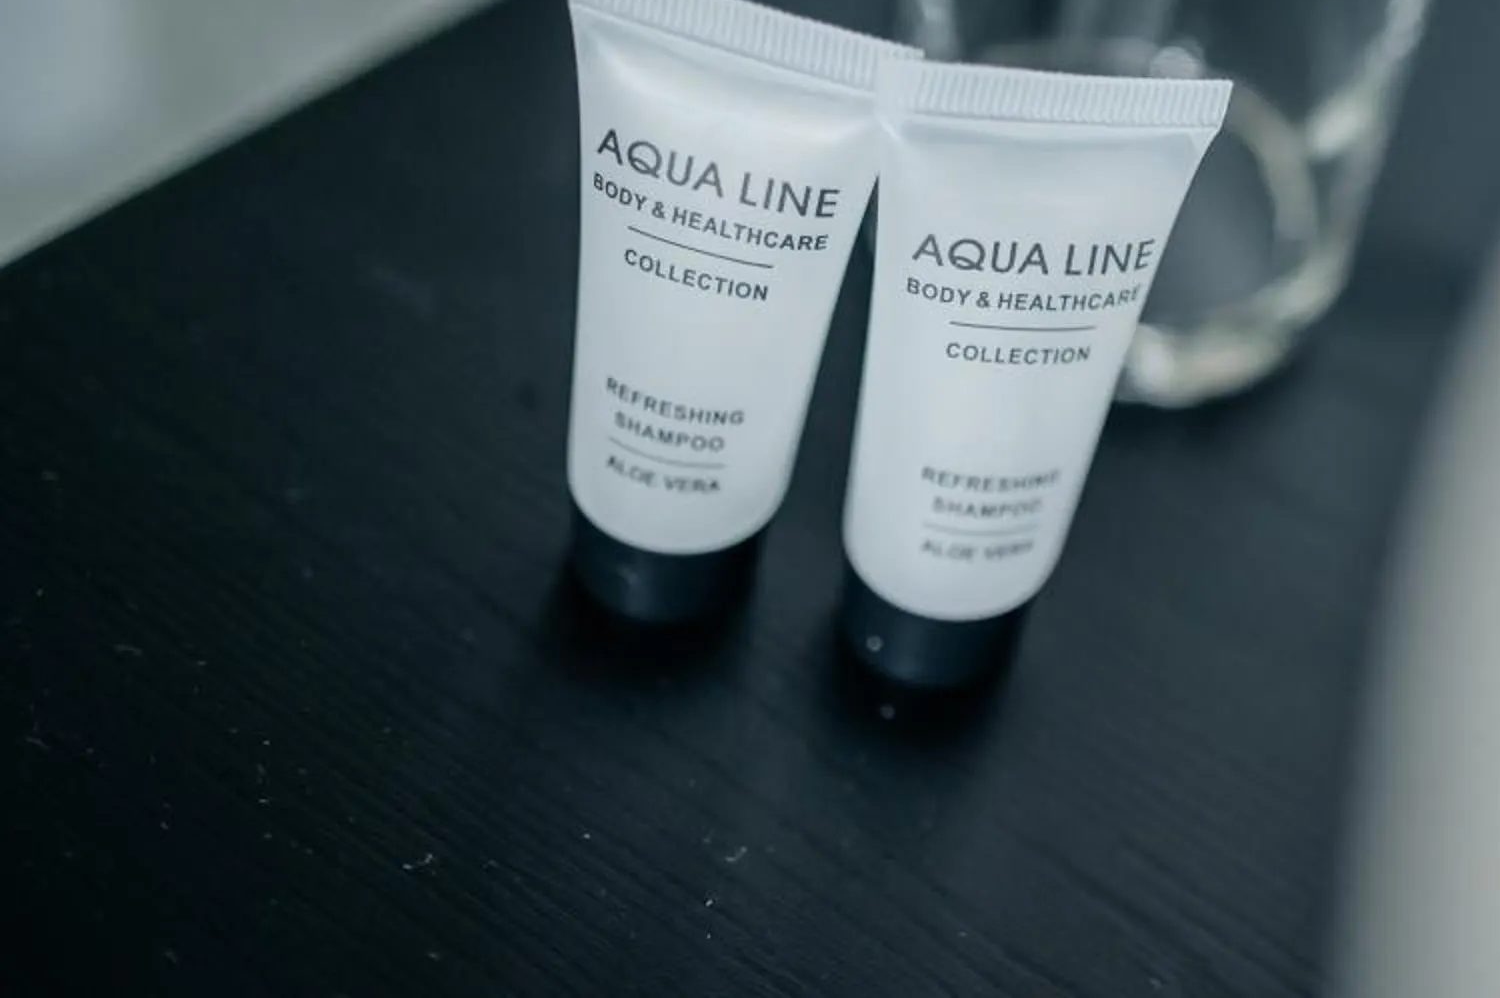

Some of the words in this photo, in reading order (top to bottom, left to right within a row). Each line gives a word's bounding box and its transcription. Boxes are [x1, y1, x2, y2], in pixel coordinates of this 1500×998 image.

[597, 128, 725, 198] AQUA
[739, 172, 840, 218] LINE
[593, 172, 648, 212] BODY
[651, 200, 666, 219] &
[671, 206, 829, 251] HEALTHCARE
[624, 248, 769, 302] COLLECTION
[912, 233, 1049, 275] AQUA
[1064, 238, 1155, 276] LINE
[906, 277, 971, 306] BODY
[976, 291, 990, 308] &
[997, 285, 1139, 311] HEALTHCARE
[945, 343, 1091, 365] COLLECTION
[606, 376, 745, 426] REFRESHING
[614, 410, 726, 453] SHAMPOO
[606, 454, 656, 487] ALOE
[663, 476, 721, 493] VERA
